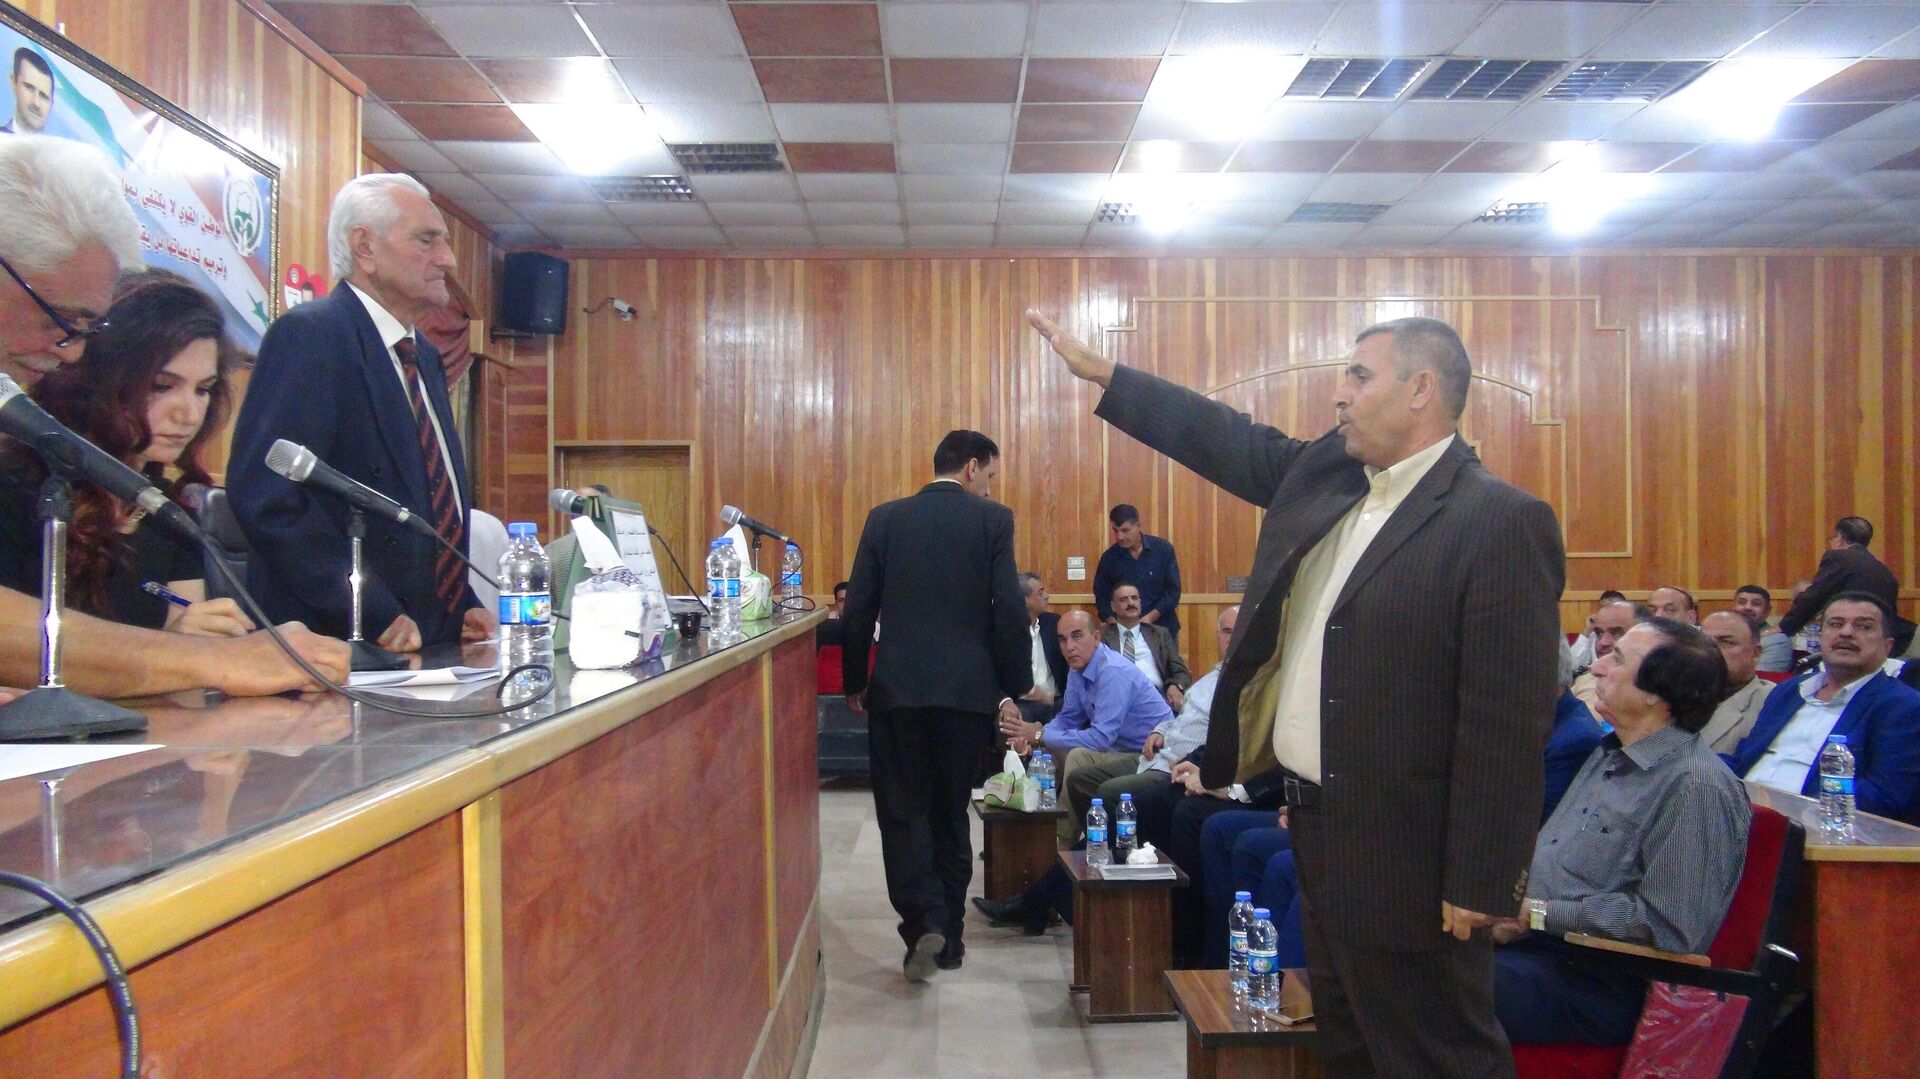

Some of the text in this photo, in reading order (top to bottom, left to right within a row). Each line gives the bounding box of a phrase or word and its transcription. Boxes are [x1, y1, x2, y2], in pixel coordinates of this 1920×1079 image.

[170, 198, 176, 213] لا
[119, 981, 133, 1008] CABLE
[130, 1014, 138, 1071] MICROPHONE
